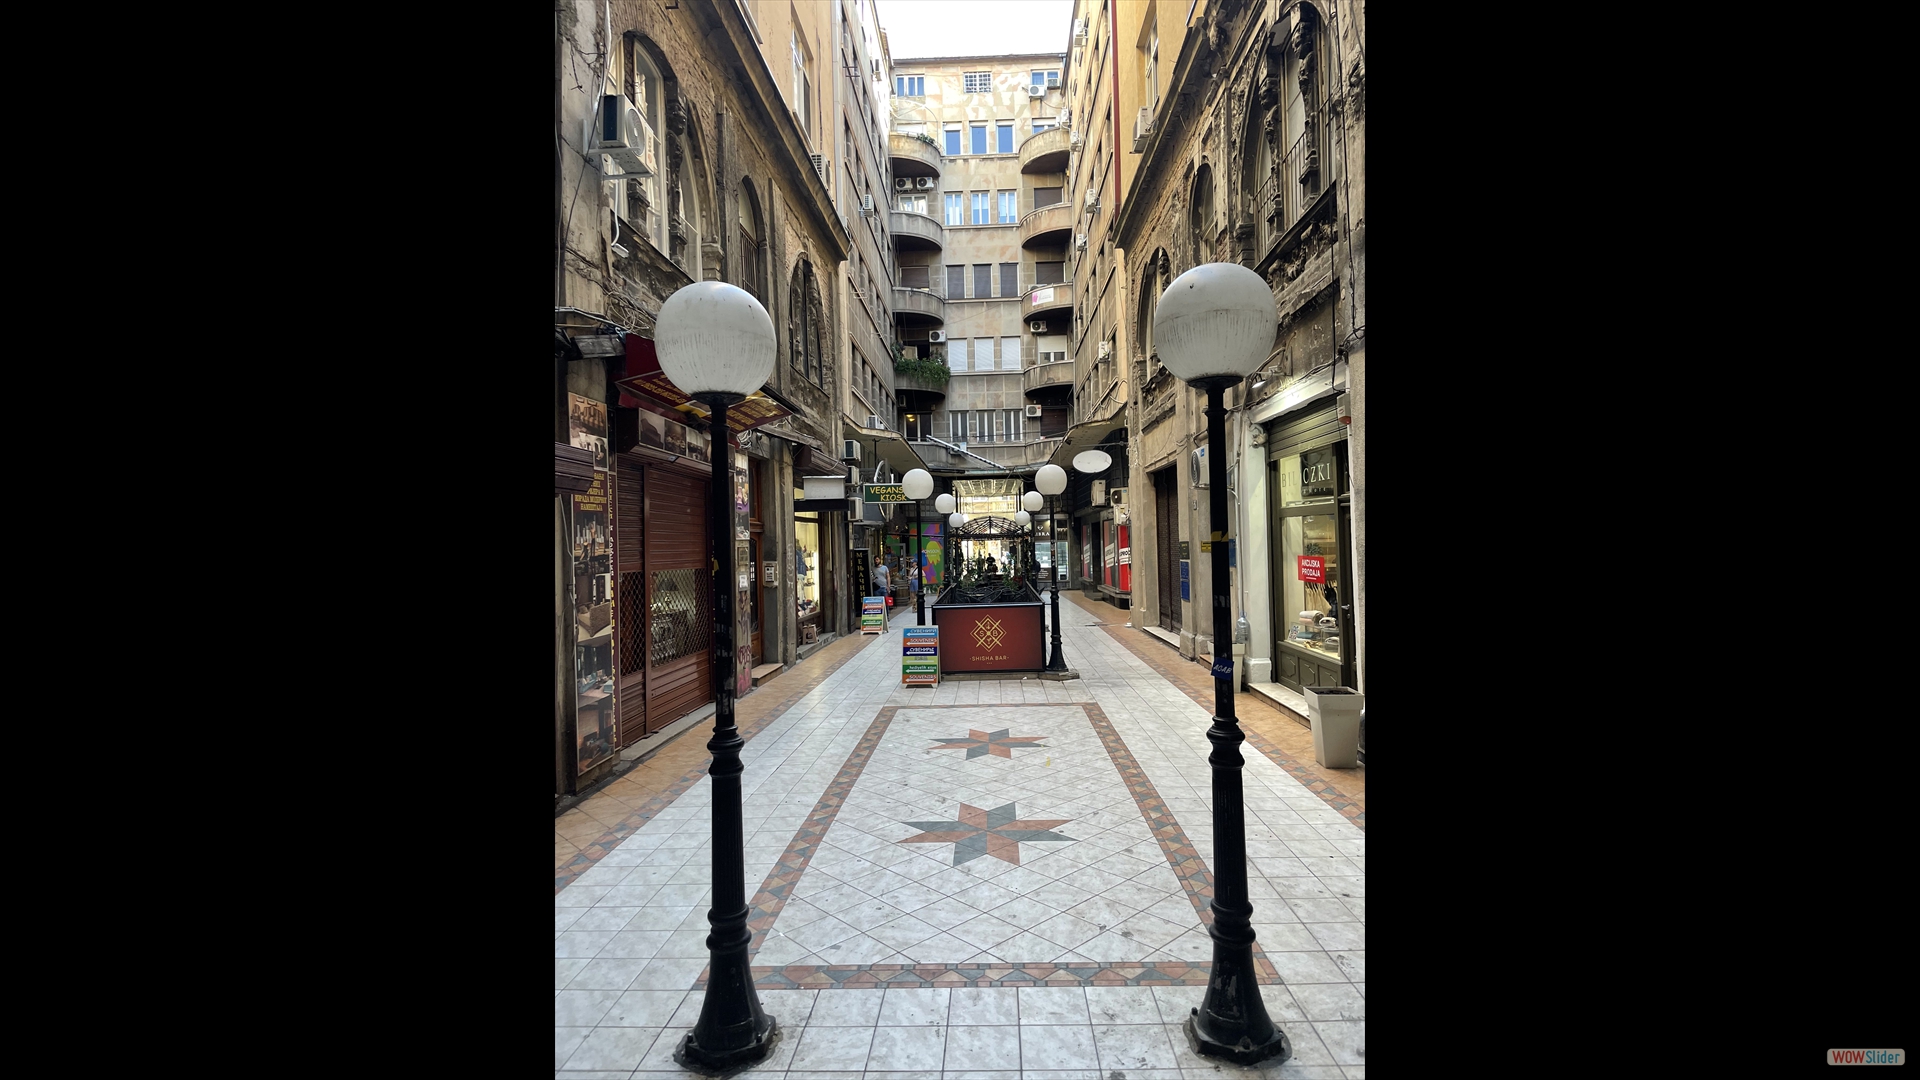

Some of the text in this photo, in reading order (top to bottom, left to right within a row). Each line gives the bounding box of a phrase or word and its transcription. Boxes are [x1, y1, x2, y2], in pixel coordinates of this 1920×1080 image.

[1282, 463, 1331, 488] BILCZKI
[870, 486, 904, 495] VEGANS
[880, 494, 907, 502] KIOSK
[1301, 567, 1321, 578] PRODAJA
